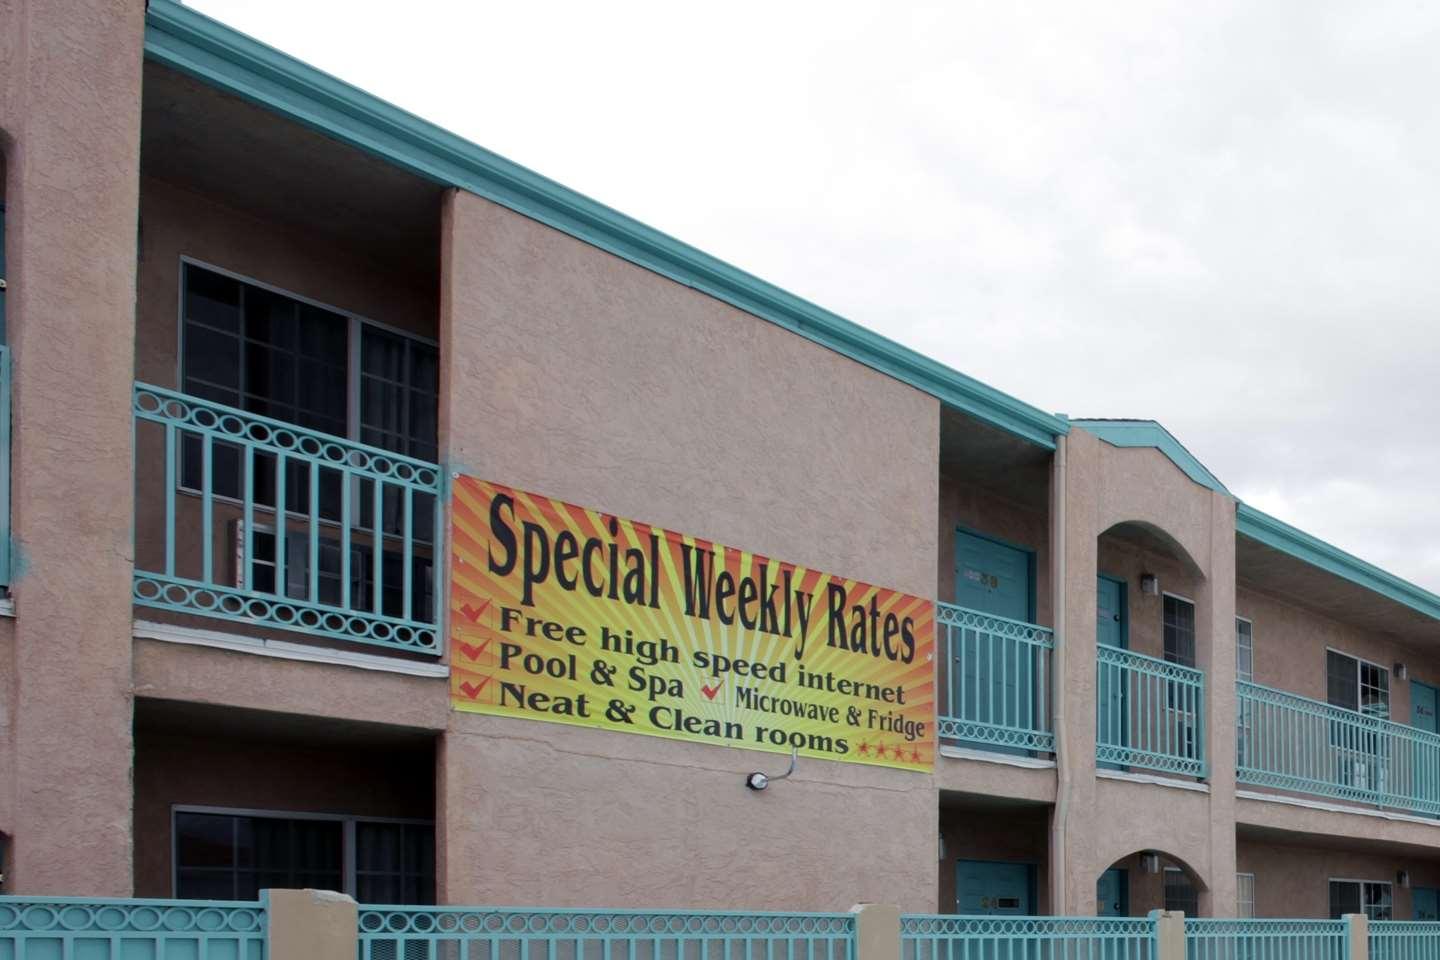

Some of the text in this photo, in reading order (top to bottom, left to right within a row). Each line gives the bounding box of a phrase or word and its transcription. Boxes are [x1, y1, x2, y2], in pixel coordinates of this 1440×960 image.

[487, 492, 916, 665] Special Weekly Rates
[500, 606, 905, 705] Free high speed internet
[500, 642, 684, 701] Pool & Spa
[500, 681, 850, 755] Neat & Clean rooms
[735, 686, 926, 741] Microwave & Fridge
